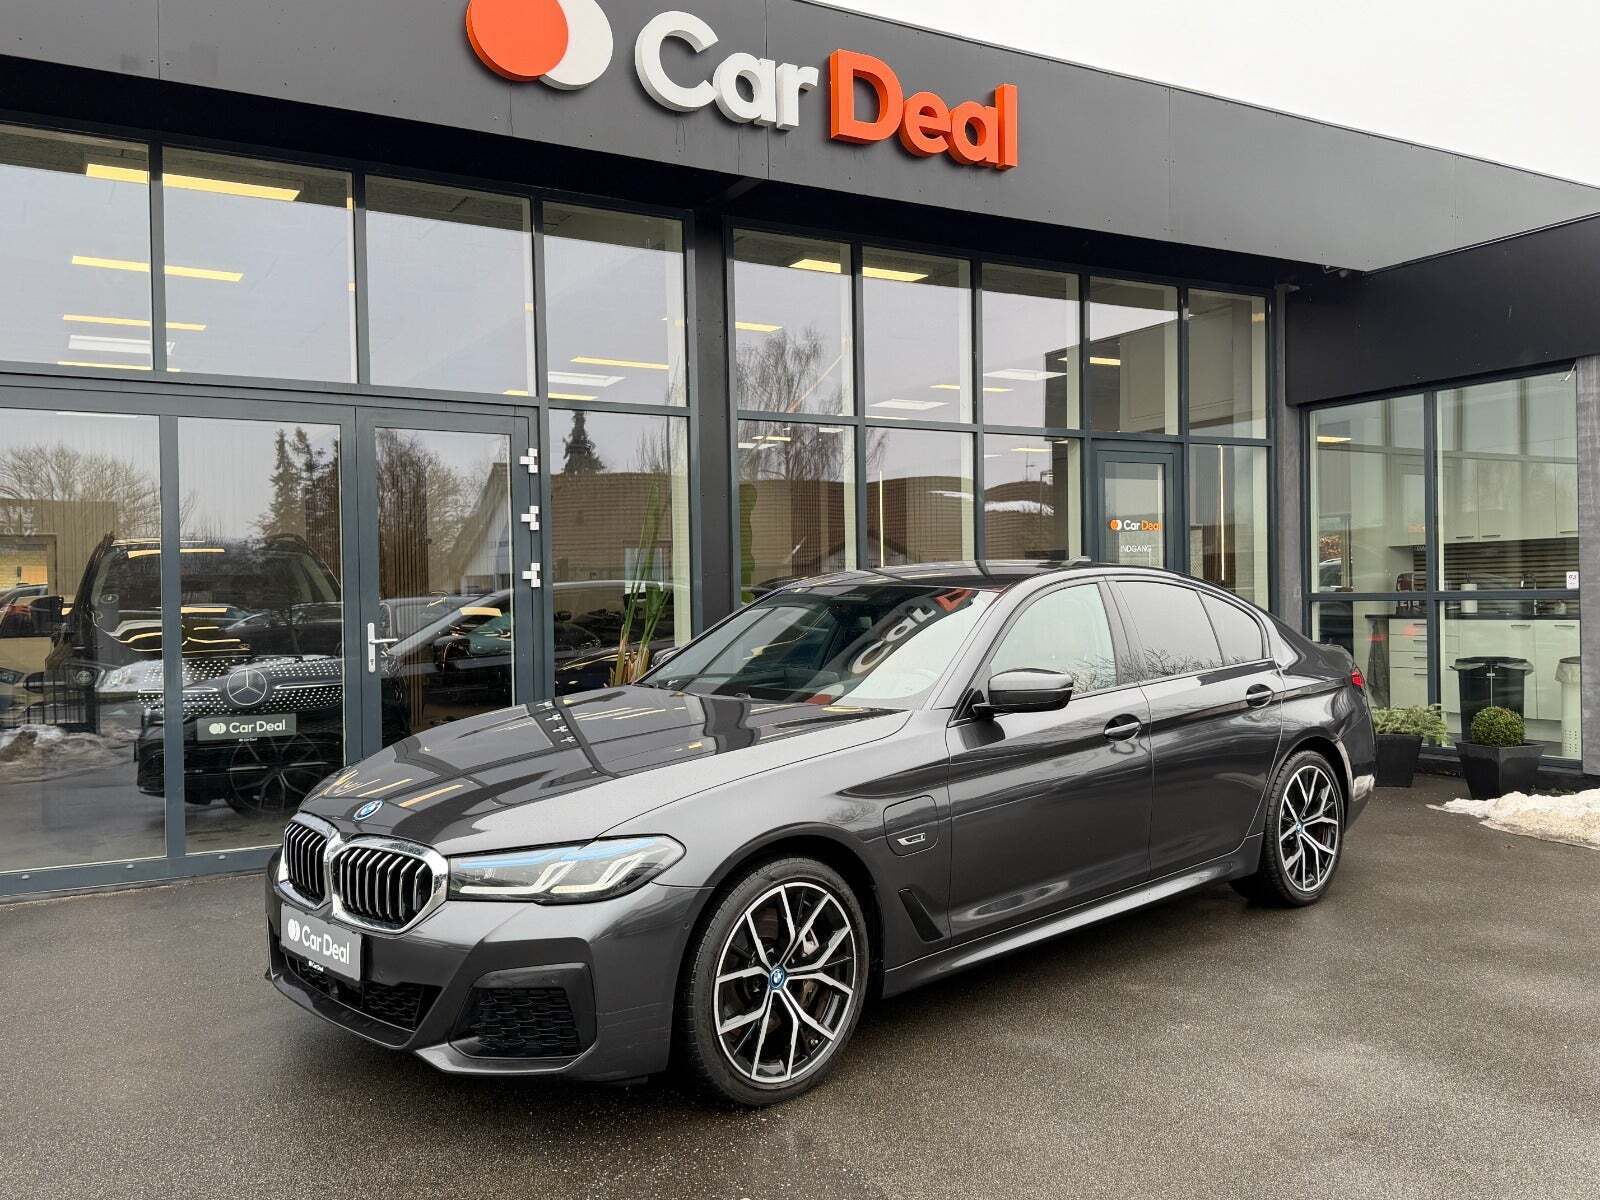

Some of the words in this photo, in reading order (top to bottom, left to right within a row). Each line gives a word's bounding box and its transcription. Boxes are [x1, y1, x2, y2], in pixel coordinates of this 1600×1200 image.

[635, 10, 818, 131] Car
[829, 48, 1018, 170] Deal
[1123, 519, 1140, 531] Car
[1141, 519, 1162, 531] Deal
[1120, 544, 1152, 553] INDGANG
[229, 722, 255, 733] Car
[256, 719, 286, 732] Deal
[301, 925, 322, 952] Car
[323, 932, 350, 965] Deal
